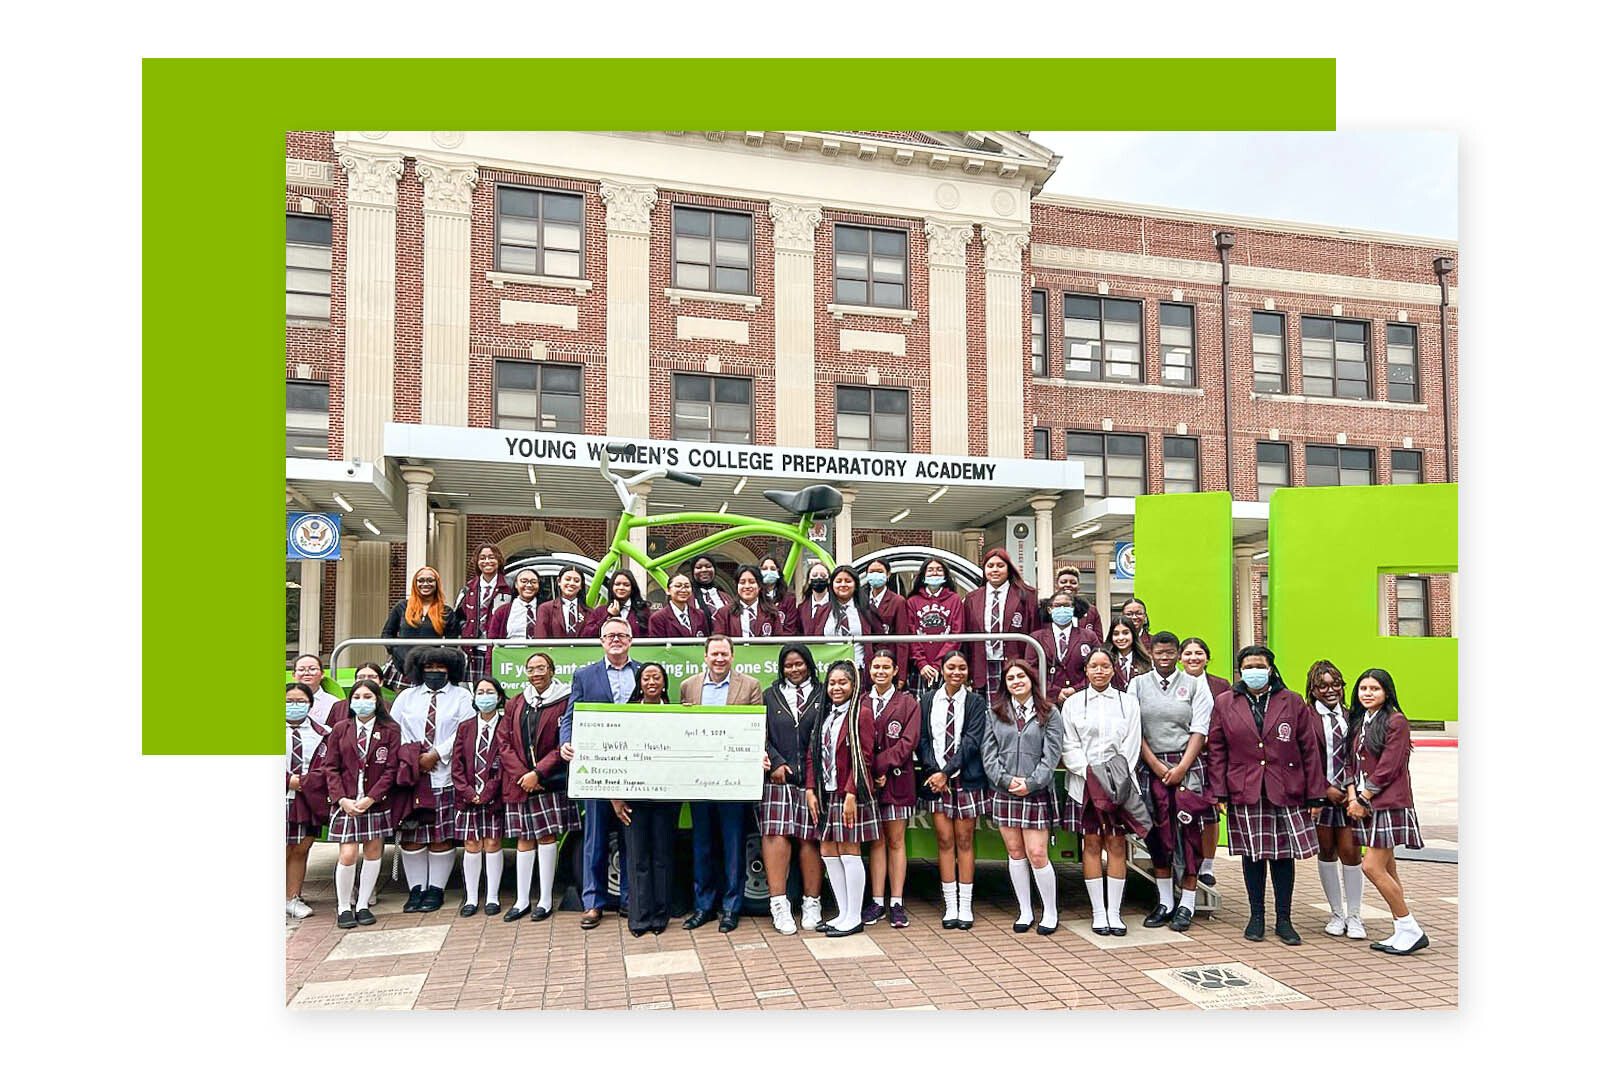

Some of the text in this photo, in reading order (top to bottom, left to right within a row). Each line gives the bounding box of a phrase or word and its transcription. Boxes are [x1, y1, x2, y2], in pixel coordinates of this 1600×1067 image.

[505, 437, 576, 459] YOUNG
[688, 448, 774, 471] COLLEGE
[782, 454, 907, 477] PREPARATORY
[915, 461, 996, 481] ACADEMY
[500, 662, 513, 675] IF
[554, 664, 578, 675] ant
[686, 661, 699, 674] in
[500, 681, 519, 690] Over
